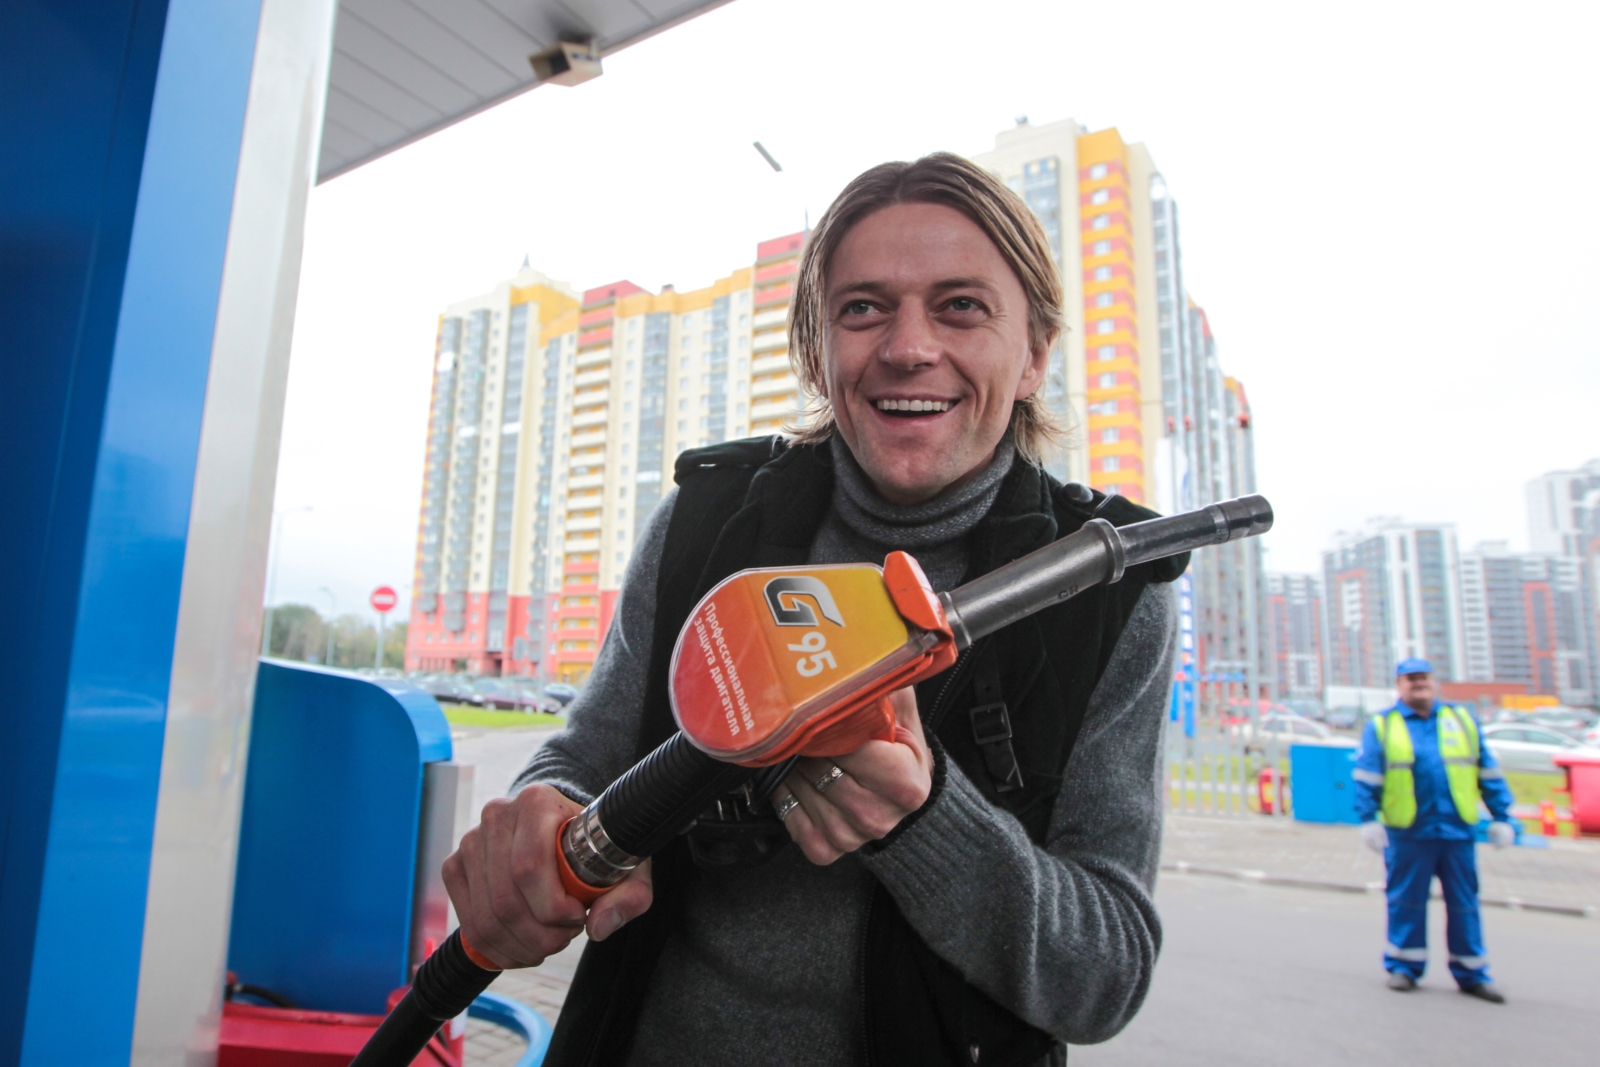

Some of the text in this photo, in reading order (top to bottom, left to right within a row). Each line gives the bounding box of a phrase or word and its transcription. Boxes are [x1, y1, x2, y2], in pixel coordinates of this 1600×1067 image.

[694, 617, 741, 737] защита двигателя
[704, 601, 755, 731] Профессиональная
[787, 631, 837, 678] 95
